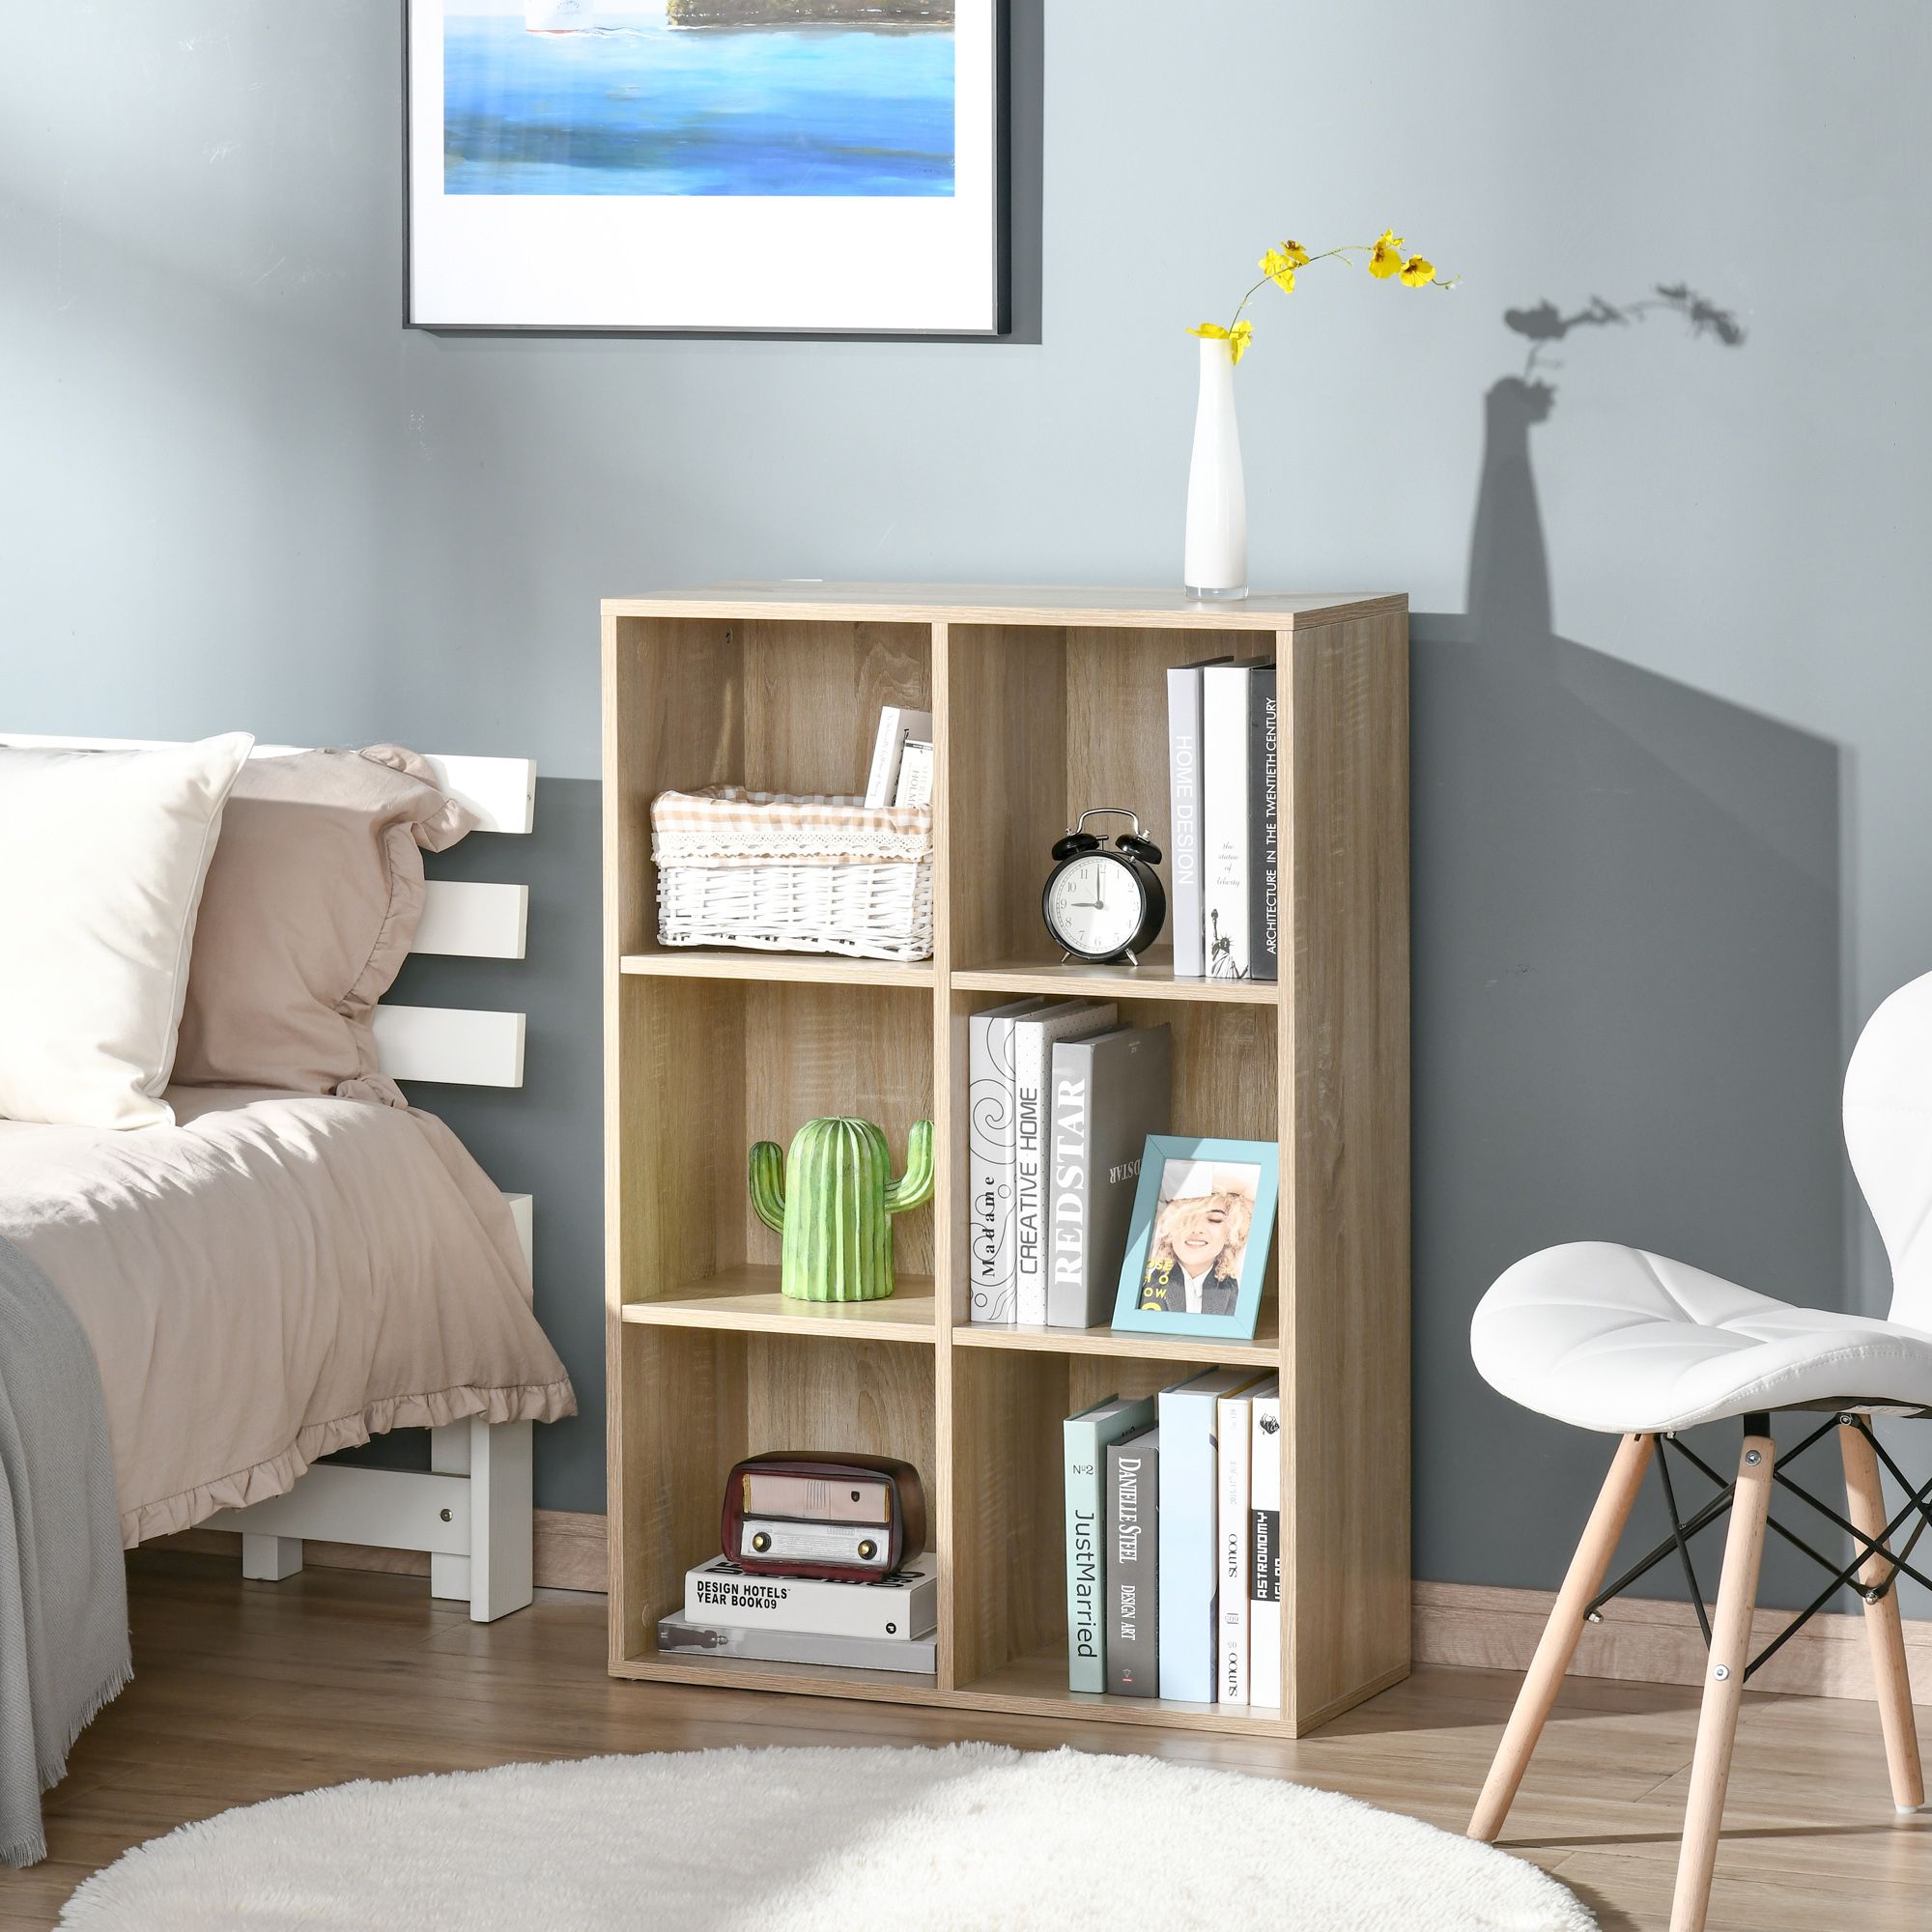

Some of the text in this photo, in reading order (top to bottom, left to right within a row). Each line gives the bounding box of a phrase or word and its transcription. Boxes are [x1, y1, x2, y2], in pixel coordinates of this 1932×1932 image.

[1176, 736, 1193, 798] HOME
[1265, 696, 1277, 955] ARCHITECTURE IN THE TWENTIETH CENTURY
[1067, 882, 1077, 893] 10
[1080, 869, 1088, 879] 11
[1060, 899, 1067, 910] 9
[1065, 918, 1072, 927] 8
[1079, 930, 1086, 941] 7
[1020, 1087, 1037, 1274] CREATIVE HOME
[1055, 1078, 1086, 1287] REDSTAR
[981, 1177, 995, 1277] Madame
[1119, 1457, 1141, 1522] DANIELLE
[1119, 1524, 1141, 1564] STEEL
[696, 1580, 739, 1596] DESIGN
[697, 1592, 726, 1605] YEAR
[1121, 1584, 1135, 1640] DESIGN ART
